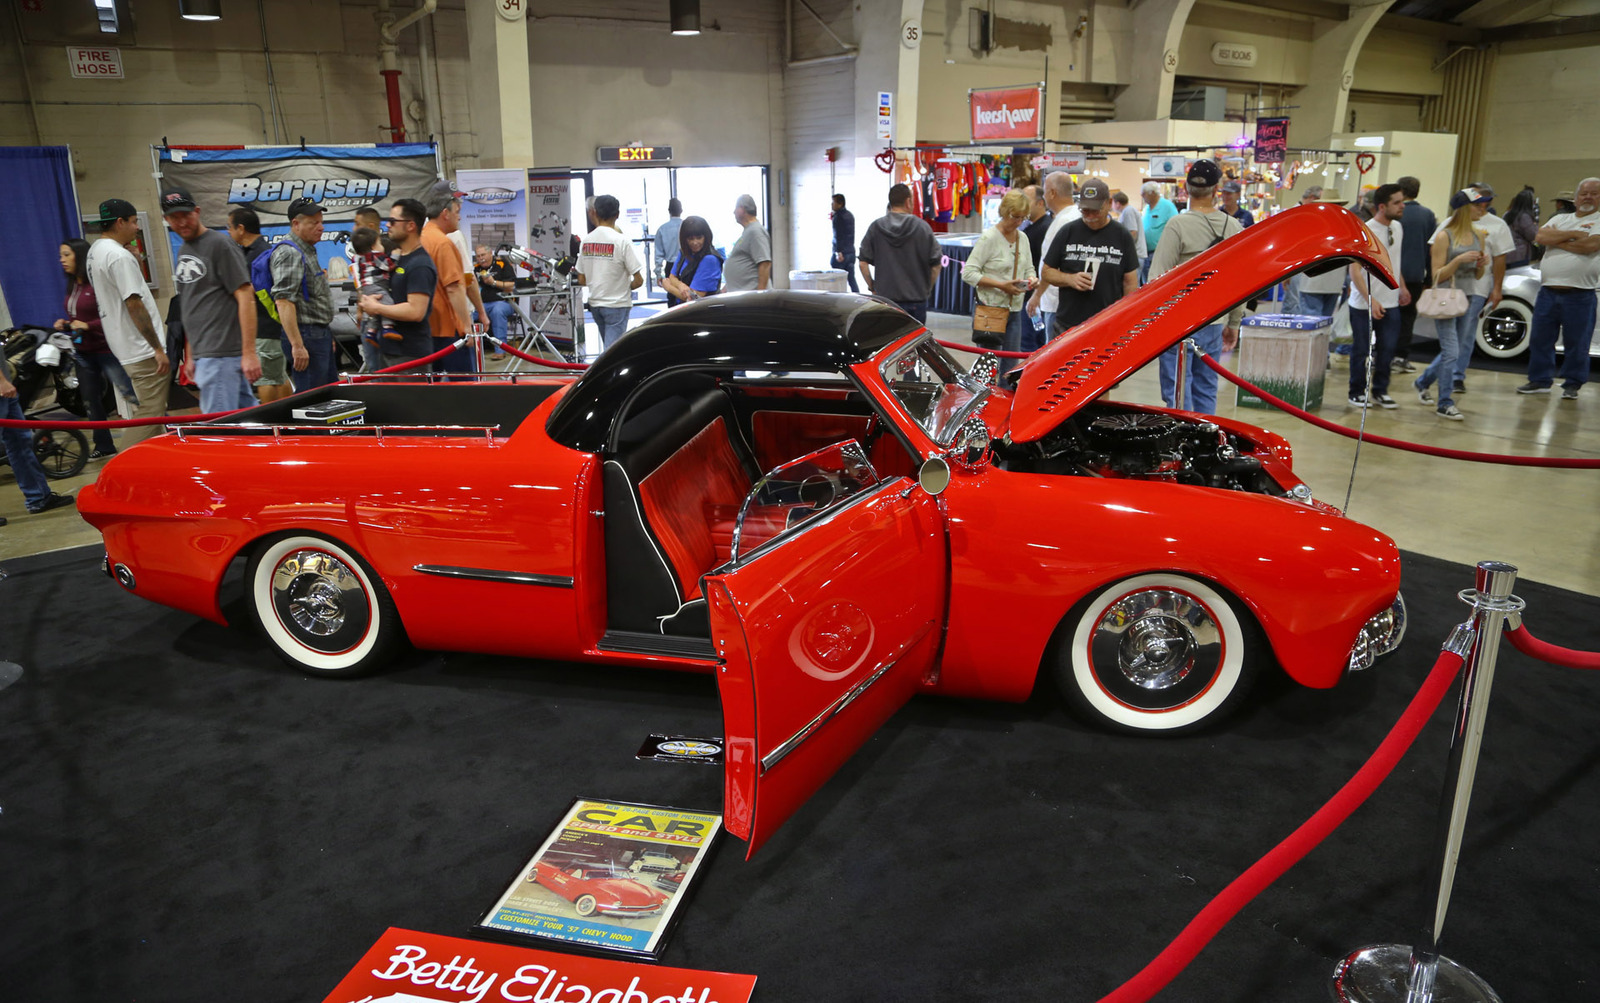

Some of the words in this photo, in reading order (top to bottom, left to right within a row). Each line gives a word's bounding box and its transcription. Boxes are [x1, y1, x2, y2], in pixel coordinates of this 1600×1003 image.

[502, 0, 520, 11] 34
[906, 27, 918, 40] 35
[78, 51, 111, 61] FIRE
[1167, 54, 1176, 66] 36
[1231, 50, 1252, 61] ROOMS
[77, 63, 117, 74] HOSE
[976, 103, 1035, 129] kershaw
[619, 147, 654, 160] EXIT
[1258, 150, 1281, 161] SALE
[228, 177, 391, 205] Bergsen
[464, 190, 517, 202] Bergsen
[324, 198, 373, 207] Metals
[1076, 243, 1097, 254] Playing
[1097, 245, 1109, 254] with
[1260, 320, 1291, 328] RECYCLE
[652, 810, 679, 818] CUSTOM
[681, 814, 715, 822] PICTORIAL
[576, 809, 705, 837] CAR
[569, 820, 618, 832] SPEED
[654, 832, 702, 843] STYLE
[499, 914, 540, 926] CUSTOMIZE
[543, 921, 564, 931] YOUR
[567, 925, 580, 933] '57
[581, 928, 608, 938] CHEVY
[609, 932, 633, 942] HOOD
[371, 945, 499, 1003] Betty
